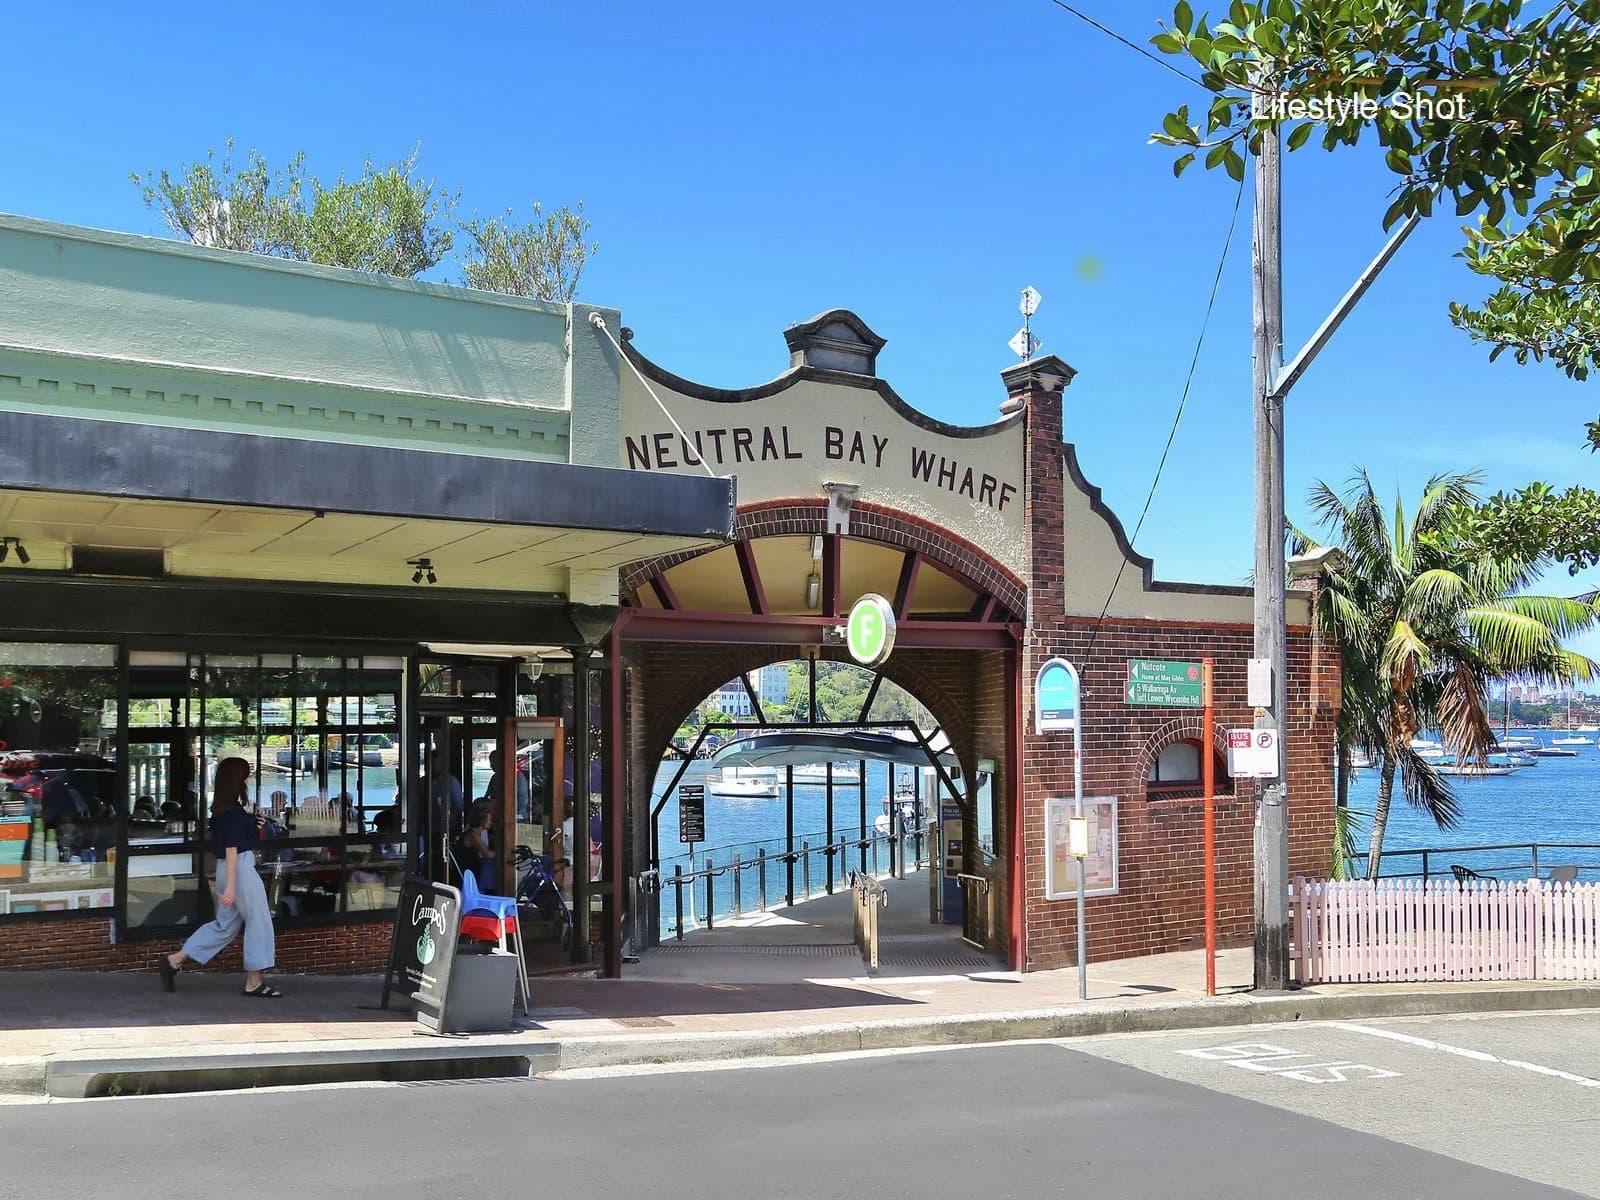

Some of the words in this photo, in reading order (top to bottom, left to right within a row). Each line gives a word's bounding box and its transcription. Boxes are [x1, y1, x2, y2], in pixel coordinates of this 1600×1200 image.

[625, 426, 803, 471] NEUTRAL
[825, 426, 889, 468] BAY
[911, 447, 1017, 512] WHARF
[860, 613, 875, 649] F
[1141, 661, 1166, 672] Nutcote
[1136, 684, 1141, 692] 5
[1147, 693, 1164, 703] Lower
[1230, 732, 1249, 740] BUS
[1231, 740, 1249, 748] ZONE
[1172, 1042, 1406, 1084] BUS
